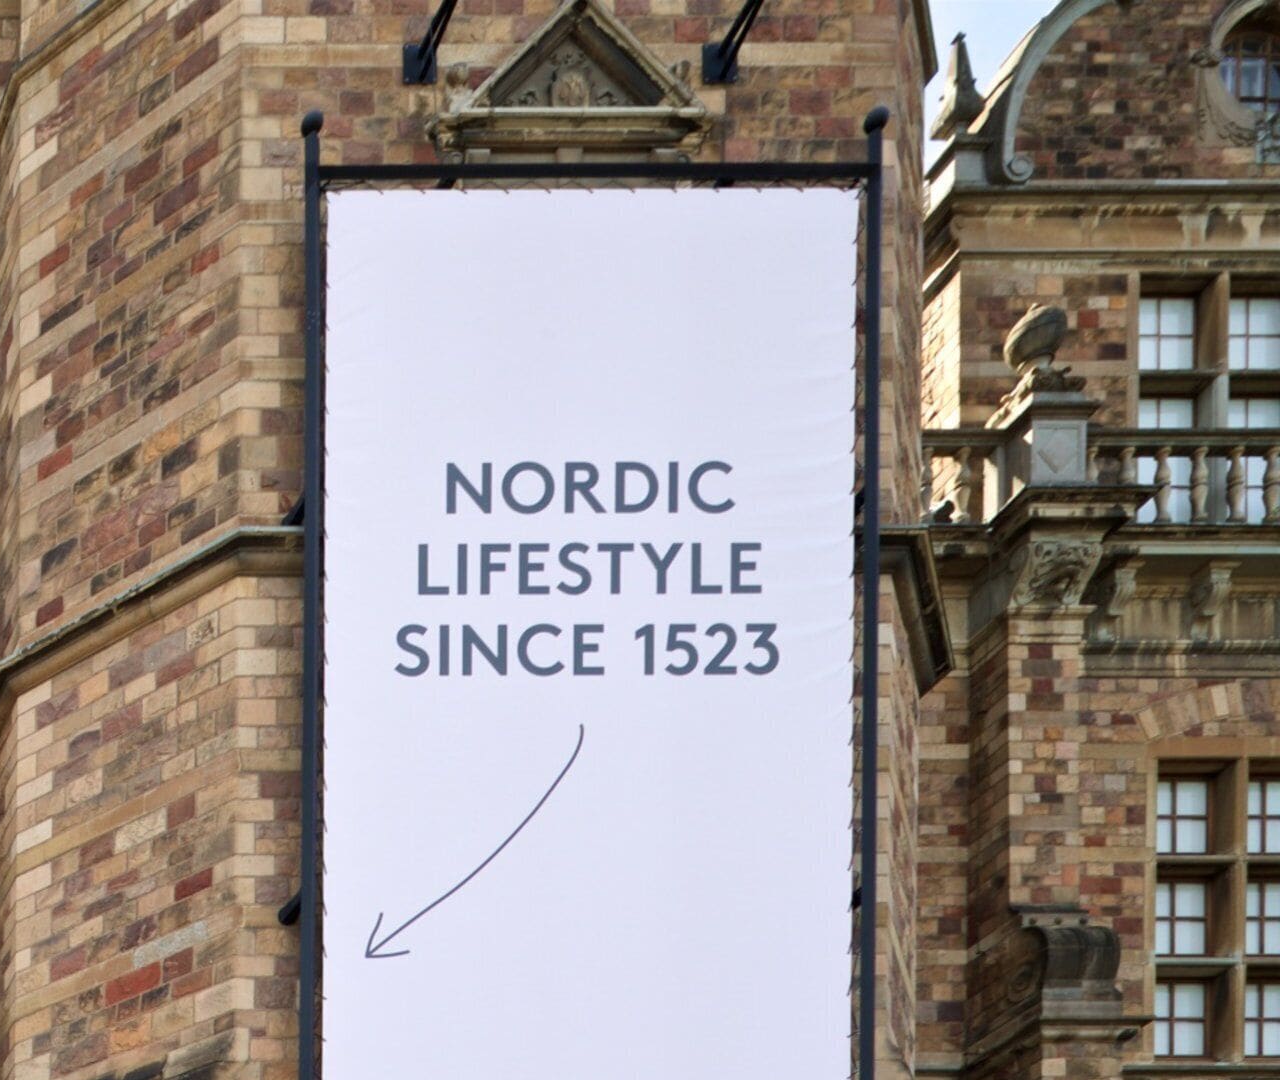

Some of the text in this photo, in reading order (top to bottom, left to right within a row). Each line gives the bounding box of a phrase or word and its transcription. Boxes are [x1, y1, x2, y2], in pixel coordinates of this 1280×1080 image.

[446, 460, 736, 515] NORDIC
[417, 541, 763, 596] LIFESTYLE
[394, 622, 780, 678] SINCE 1523
